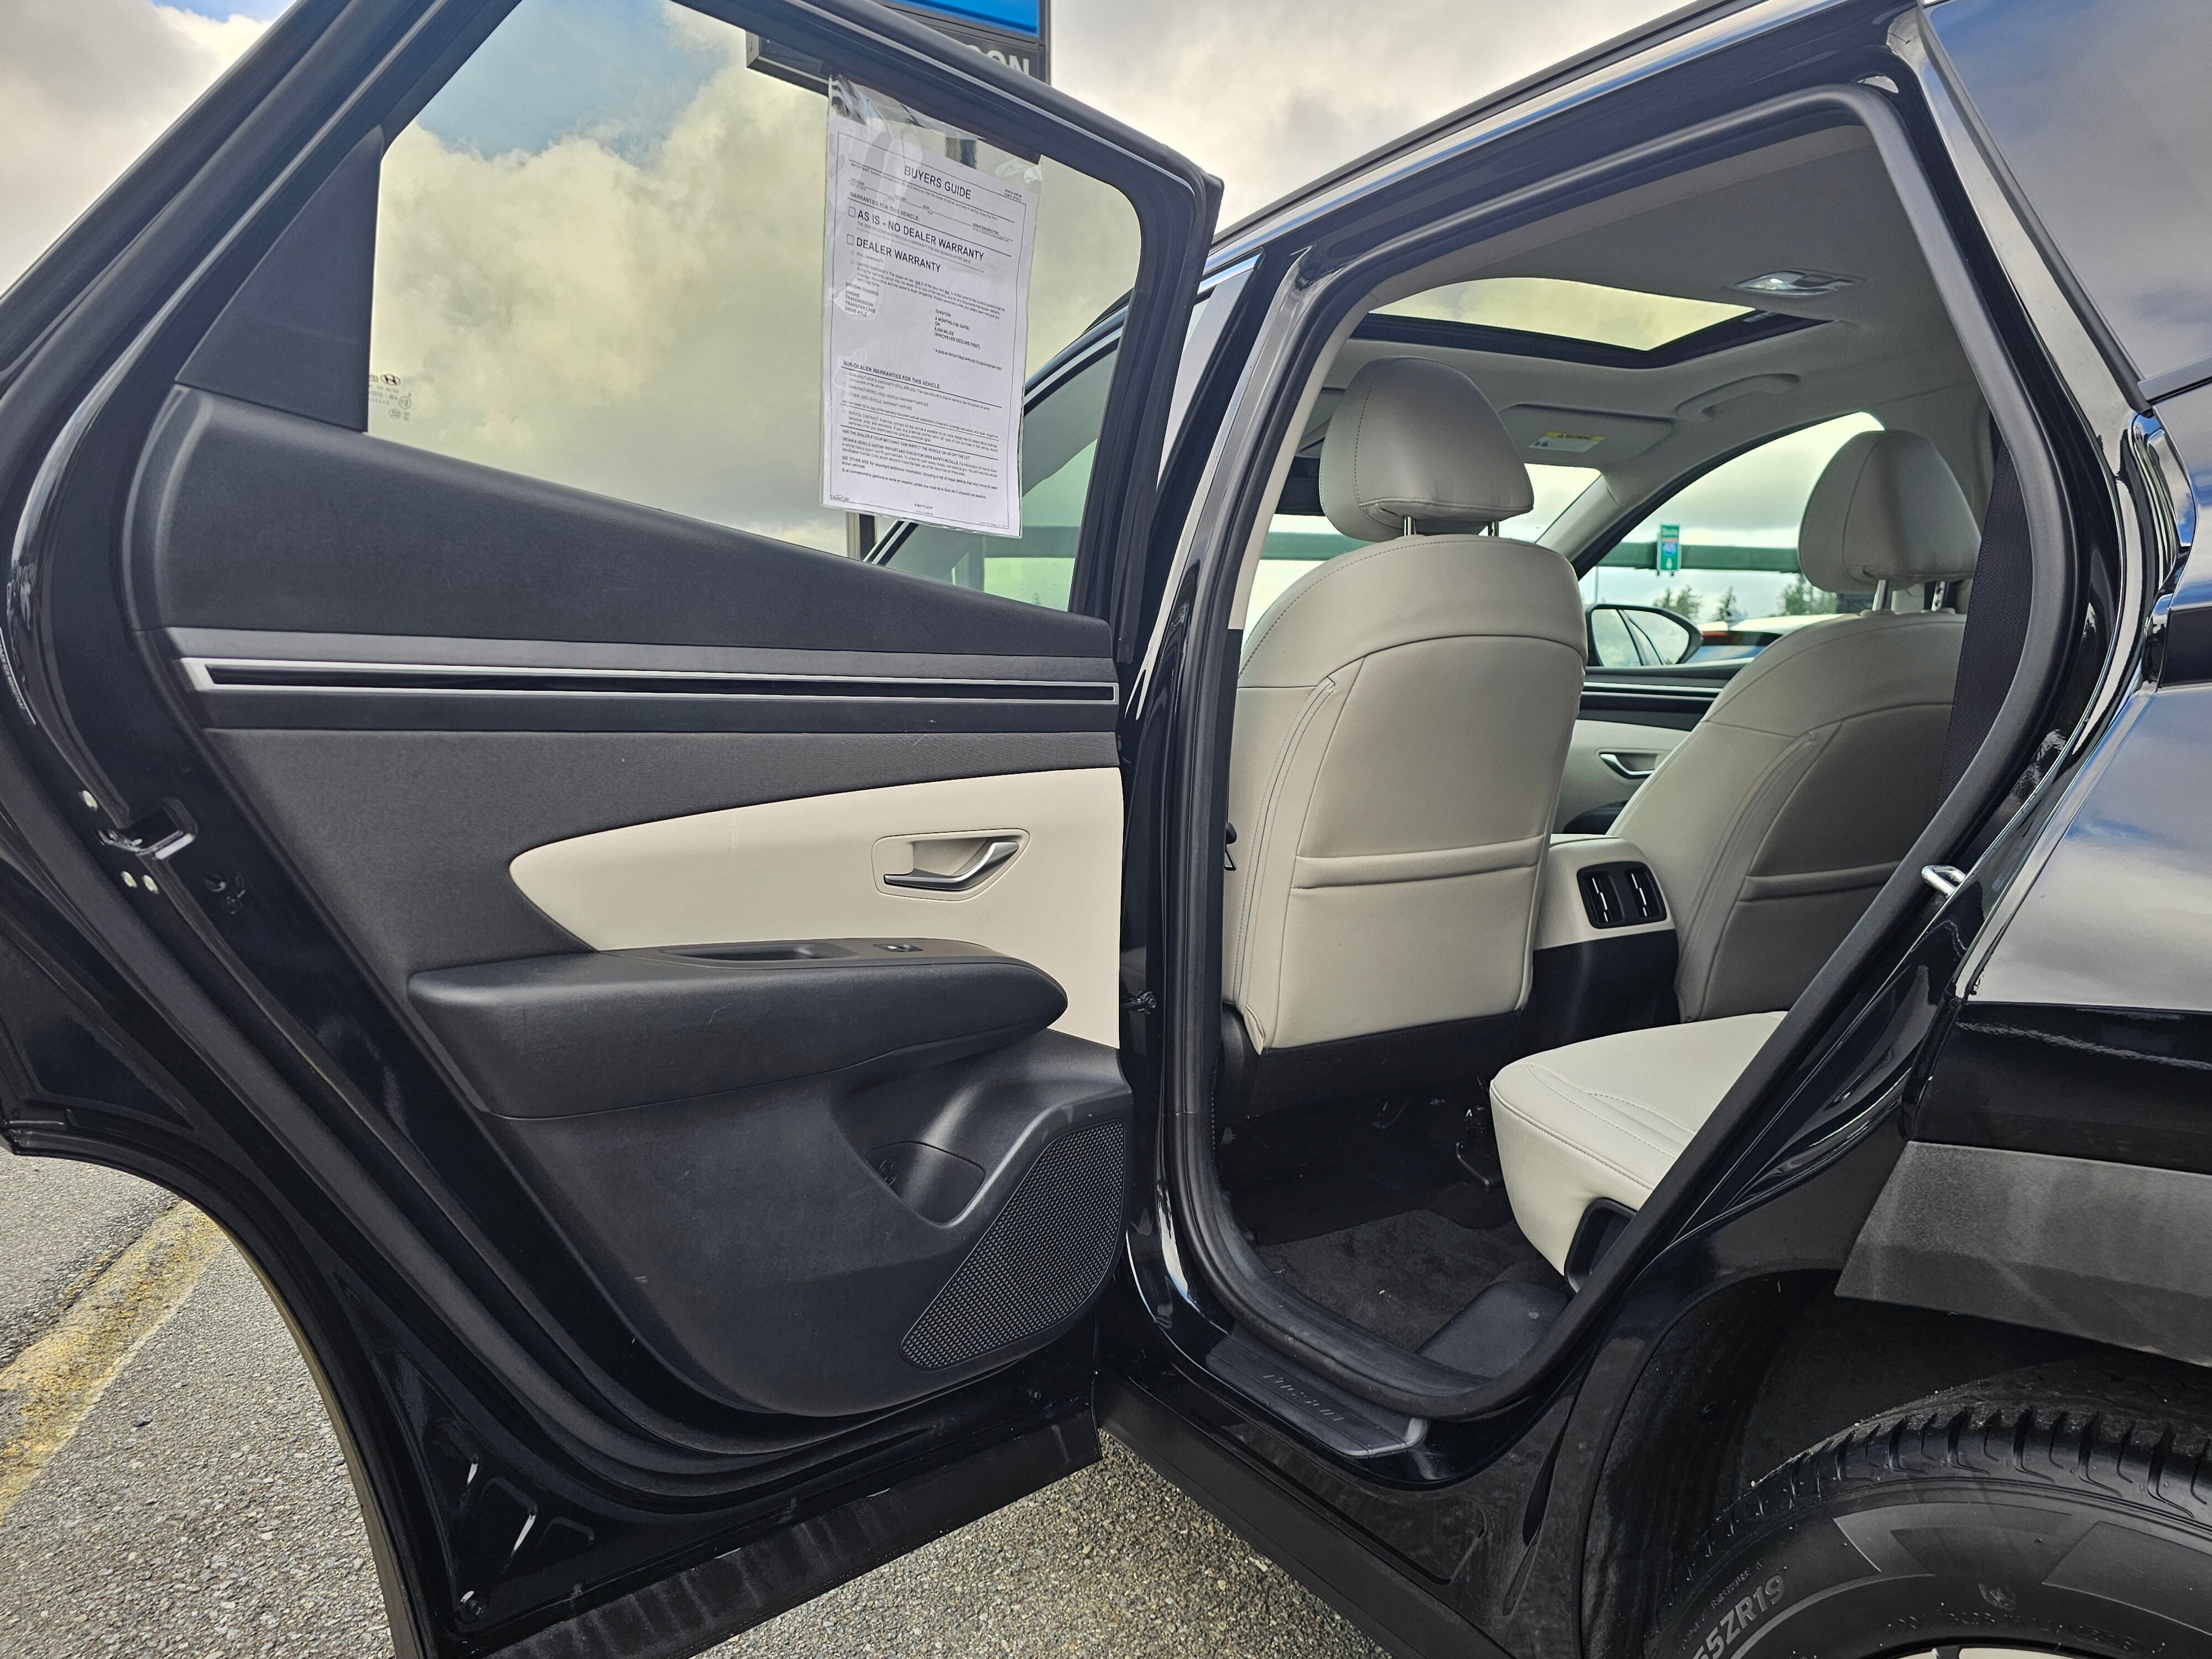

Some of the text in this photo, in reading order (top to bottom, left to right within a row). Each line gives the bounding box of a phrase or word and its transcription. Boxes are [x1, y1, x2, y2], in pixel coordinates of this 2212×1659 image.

[904, 165, 941, 189] BUYERS
[944, 180, 971, 200] GUIDE
[850, 191, 878, 206] WARRANTIES
[857, 210, 869, 222] AS
[872, 215, 879, 225] IS
[888, 221, 900, 232] NO
[903, 226, 936, 245] DEALER
[938, 238, 984, 262] WARRANTY
[857, 237, 941, 273] DEALER WARRANTY
[845, 301, 865, 310] TRANSFER
[843, 361, 872, 372] NON-DEALER
[873, 368, 901, 379] WARRANTIES
